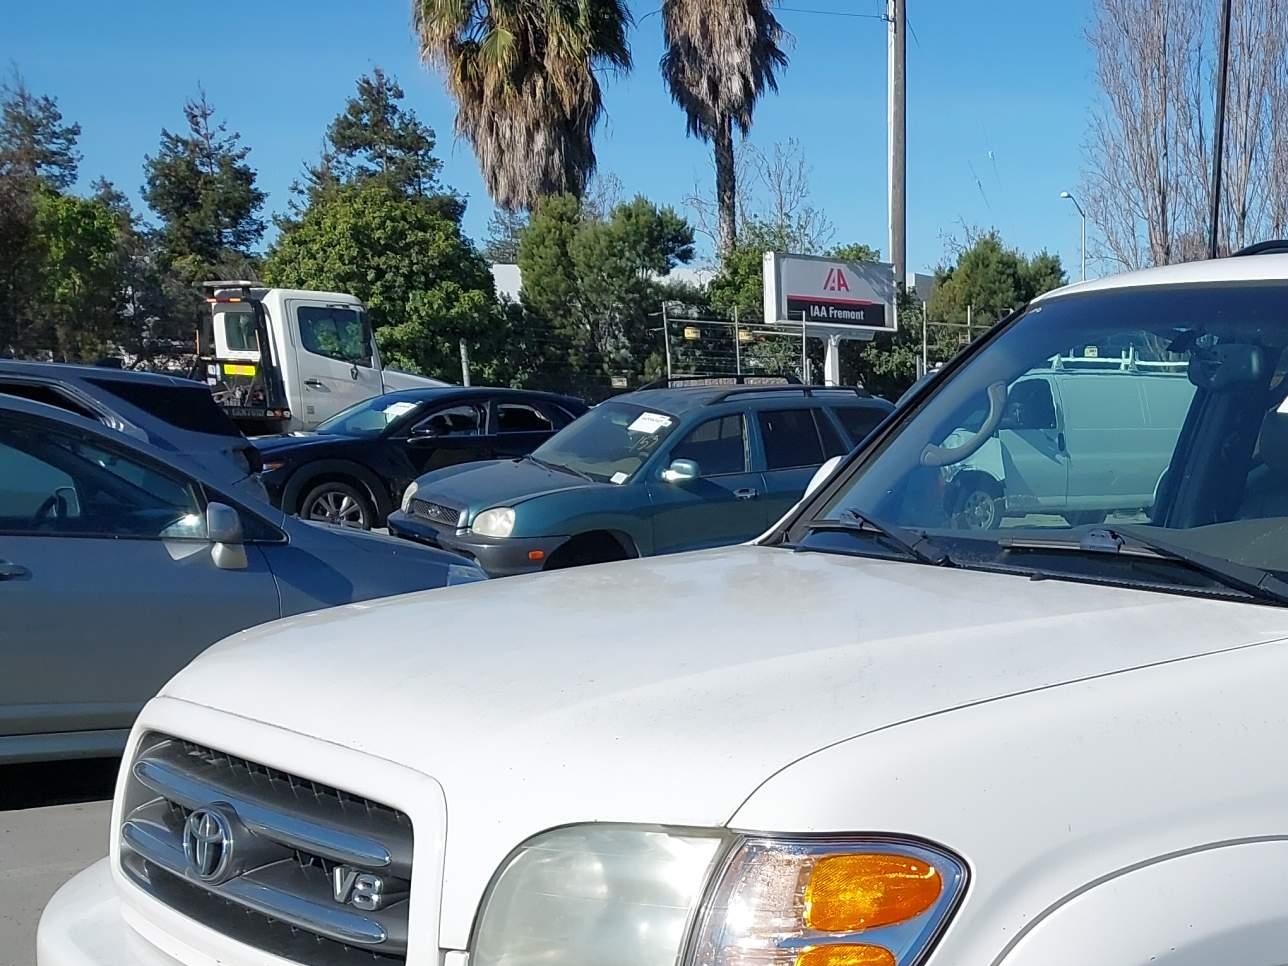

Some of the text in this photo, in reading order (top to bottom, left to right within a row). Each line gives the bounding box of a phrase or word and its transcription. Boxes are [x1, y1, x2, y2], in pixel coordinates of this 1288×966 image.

[810, 305, 865, 320] IAA Fremont
[333, 866, 384, 911] V8
